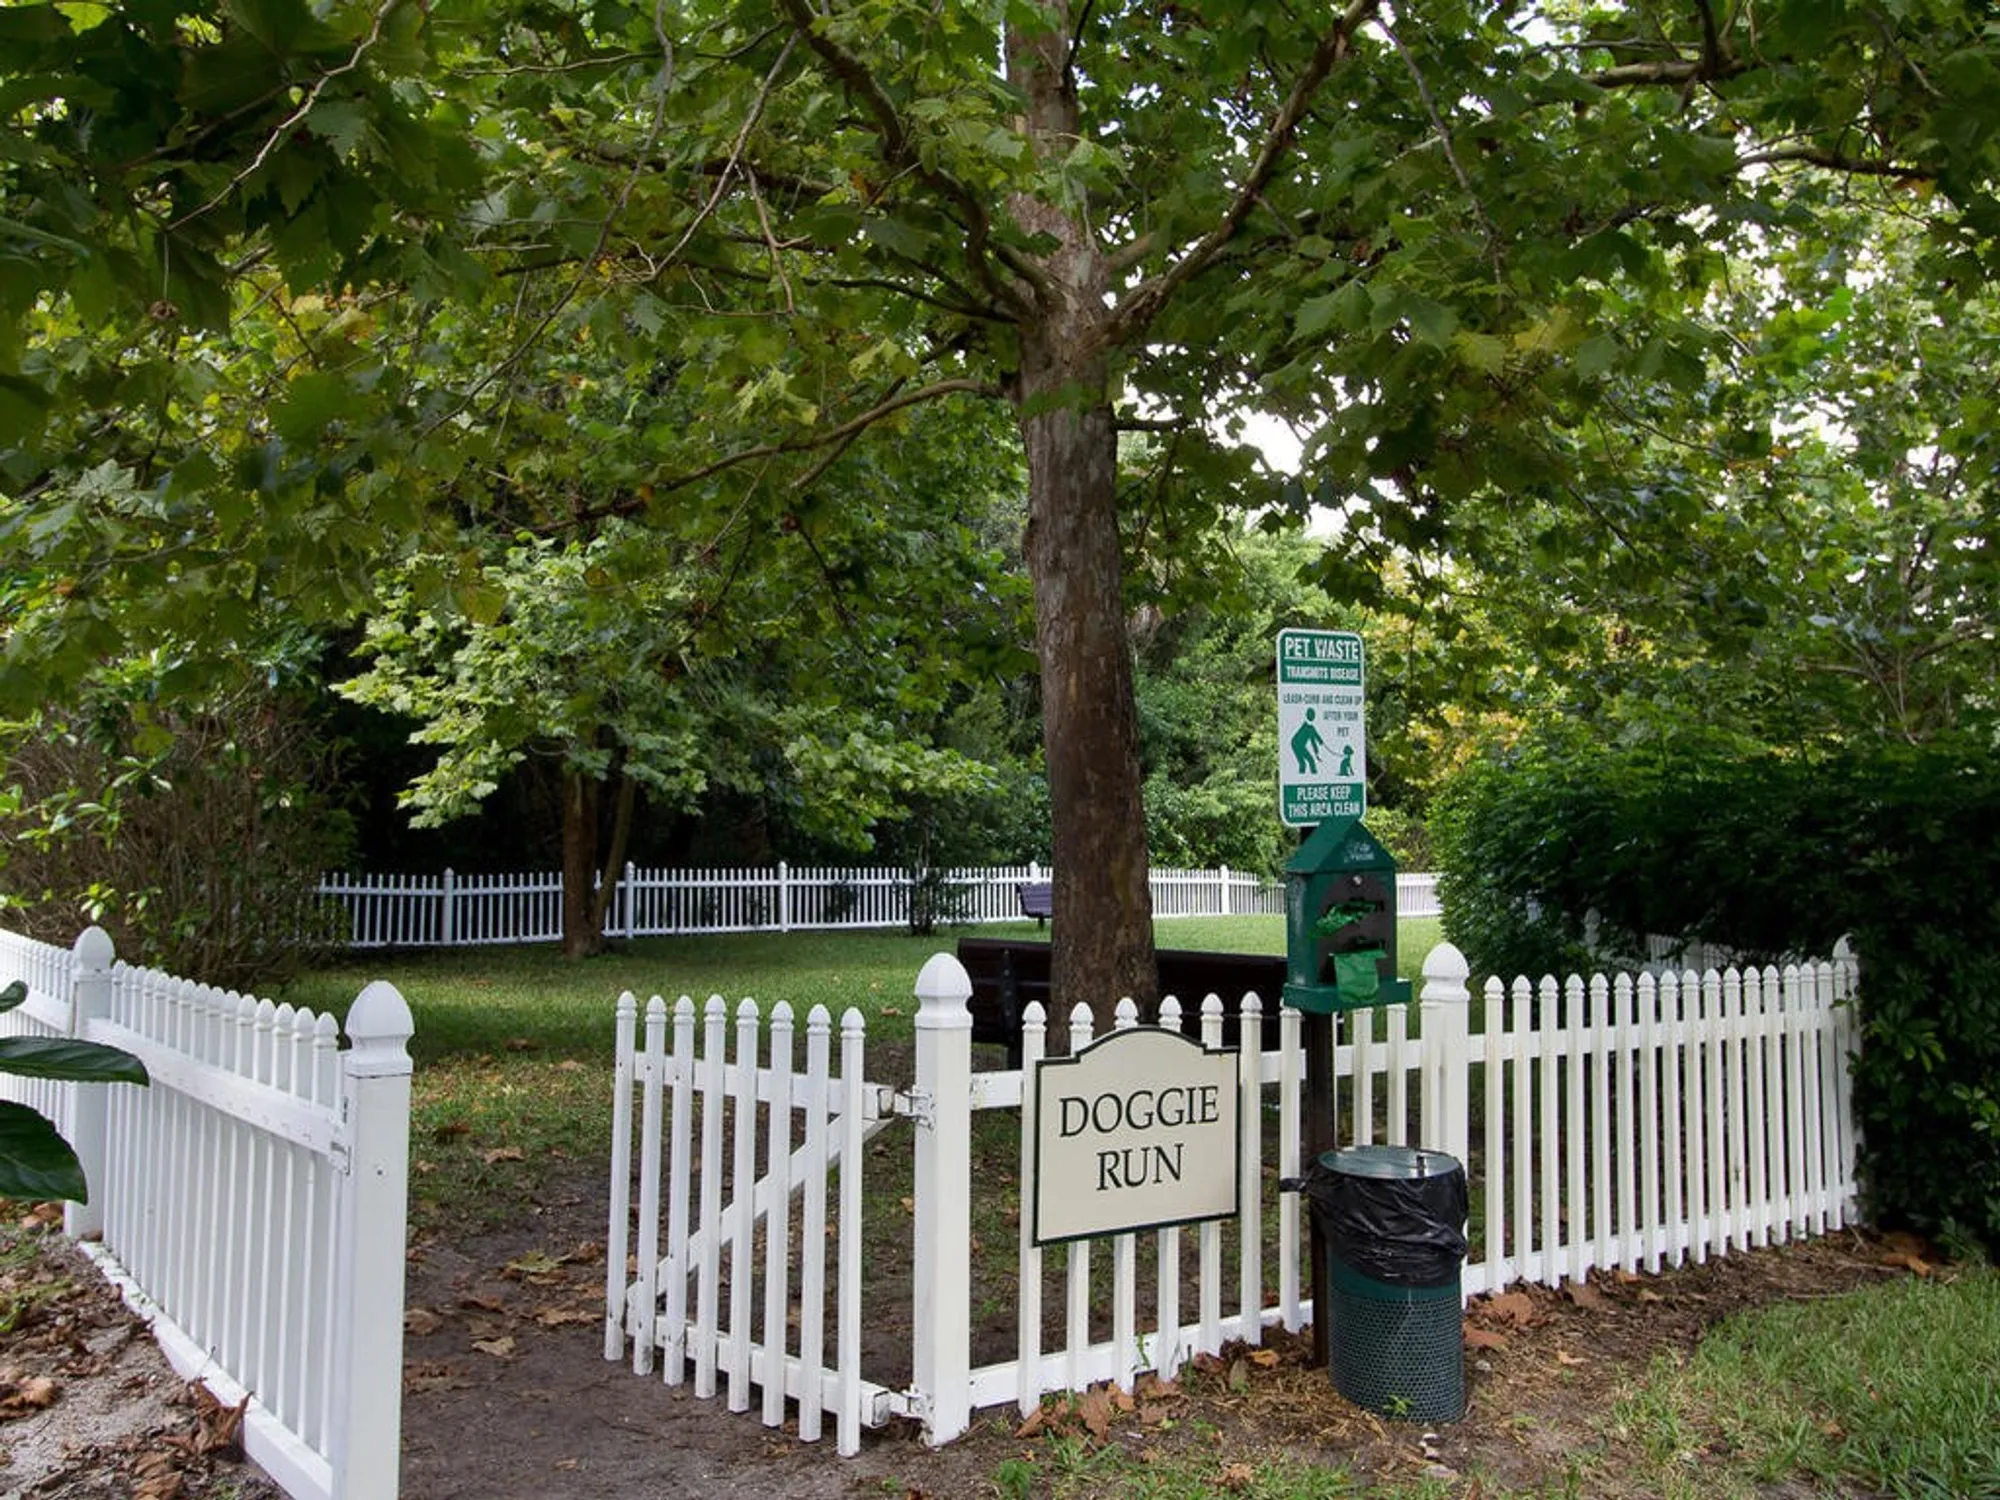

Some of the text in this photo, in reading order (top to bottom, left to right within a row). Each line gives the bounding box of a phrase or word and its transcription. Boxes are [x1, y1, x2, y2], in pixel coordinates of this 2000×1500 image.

[1285, 636, 1359, 660] PET WASTE
[1337, 727, 1350, 737] PET
[1297, 786, 1351, 801] PLEASE KEEP
[1288, 801, 1360, 818] THIS AREA CLEAN
[1059, 1085, 1220, 1138] DOGGIE
[1096, 1143, 1184, 1191] RUN
